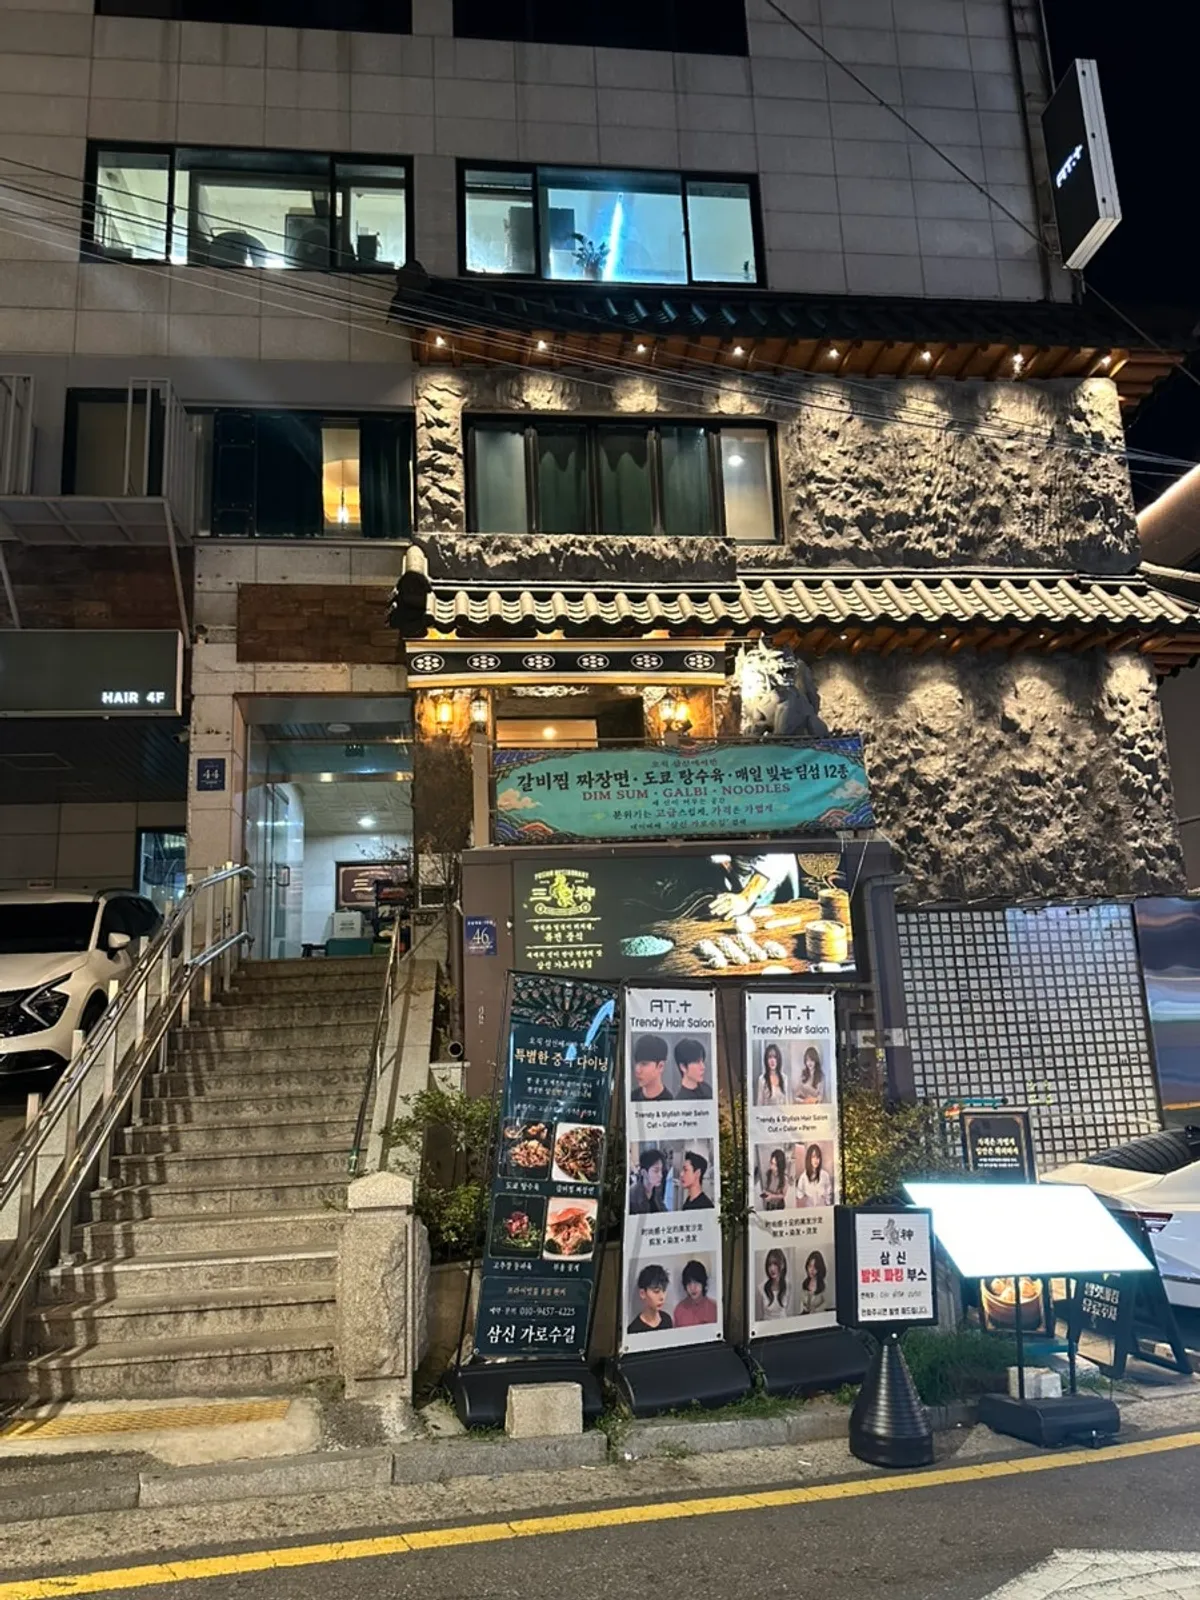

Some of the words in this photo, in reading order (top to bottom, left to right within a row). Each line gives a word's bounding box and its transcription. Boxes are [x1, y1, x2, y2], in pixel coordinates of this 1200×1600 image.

[101, 691, 139, 704] HAIR
[146, 691, 165, 704] 4F
[203, 769, 220, 779] 44
[517, 770, 569, 792] 갈비찜
[576, 769, 630, 790] 짜장면
[678, 768, 725, 785] 탕수육
[735, 766, 763, 783] 매일
[766, 765, 794, 782] 빚는
[796, 764, 820, 780] 딤섬
[824, 764, 849, 780] 12종
[582, 791, 612, 801] DIM
[616, 789, 649, 800] SUM
[663, 787, 708, 798] GALBI
[722, 783, 790, 795] NOODLES
[613, 809, 652, 820] 분위기는
[712, 805, 741, 816] 가격은
[744, 803, 773, 815] 가볍게
[472, 927, 490, 945] 46
[630, 1017, 664, 1029] Trendy
[666, 1017, 685, 1028] Hair
[687, 1017, 715, 1028] Salon
[752, 1025, 783, 1037] Trendy
[784, 1025, 803, 1035] Hair
[805, 1025, 830, 1034] Salon
[514, 1048, 549, 1066] 특별한
[577, 1055, 608, 1072] 다이닝
[635, 1111, 655, 1119] Trendy
[661, 1110, 680, 1118] Stylish
[693, 1109, 709, 1117] Salon
[646, 1121, 657, 1129] Cut
[870, 1229, 885, 1240] 三
[884, 1268, 904, 1282] 파킹
[907, 1268, 927, 1282] 부스
[487, 1324, 516, 1344] 삼신
[520, 1324, 576, 1344] 가로수길
